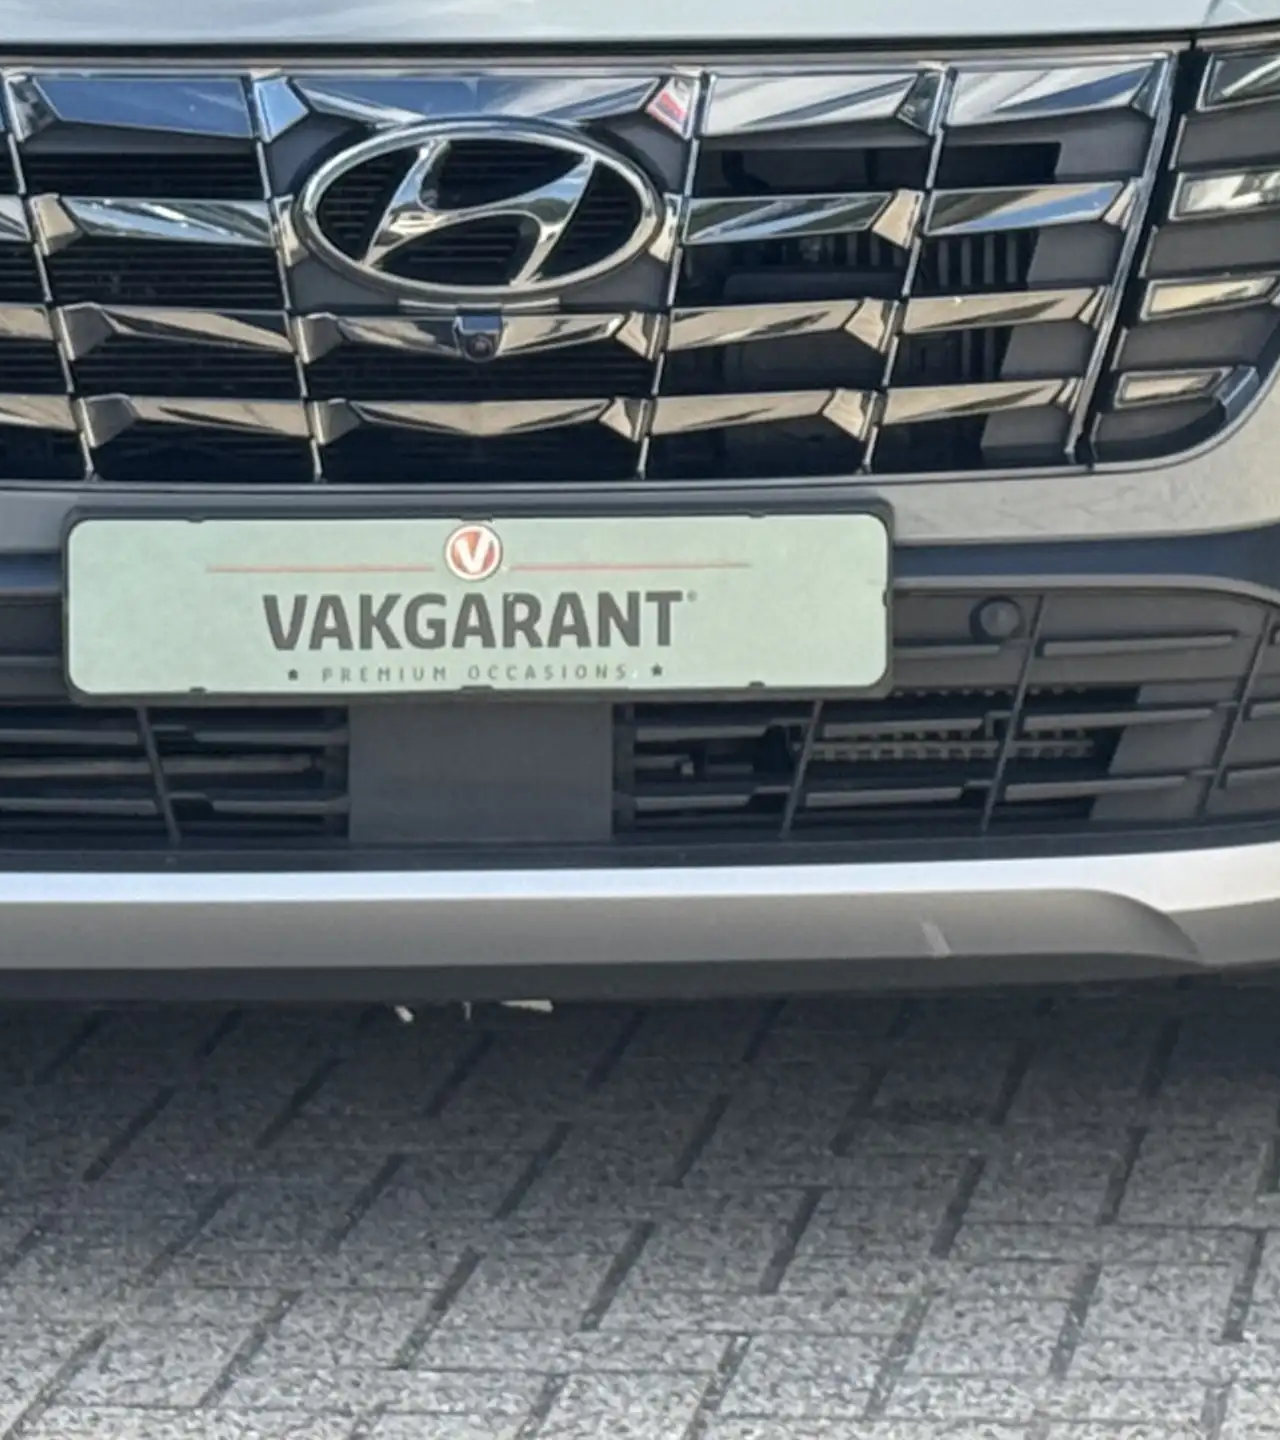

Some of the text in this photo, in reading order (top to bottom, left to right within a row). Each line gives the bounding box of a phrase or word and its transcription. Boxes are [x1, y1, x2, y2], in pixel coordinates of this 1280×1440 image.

[262, 590, 684, 651] VAKGARANT
[321, 663, 627, 683] PREMIUM OCCASIONS
